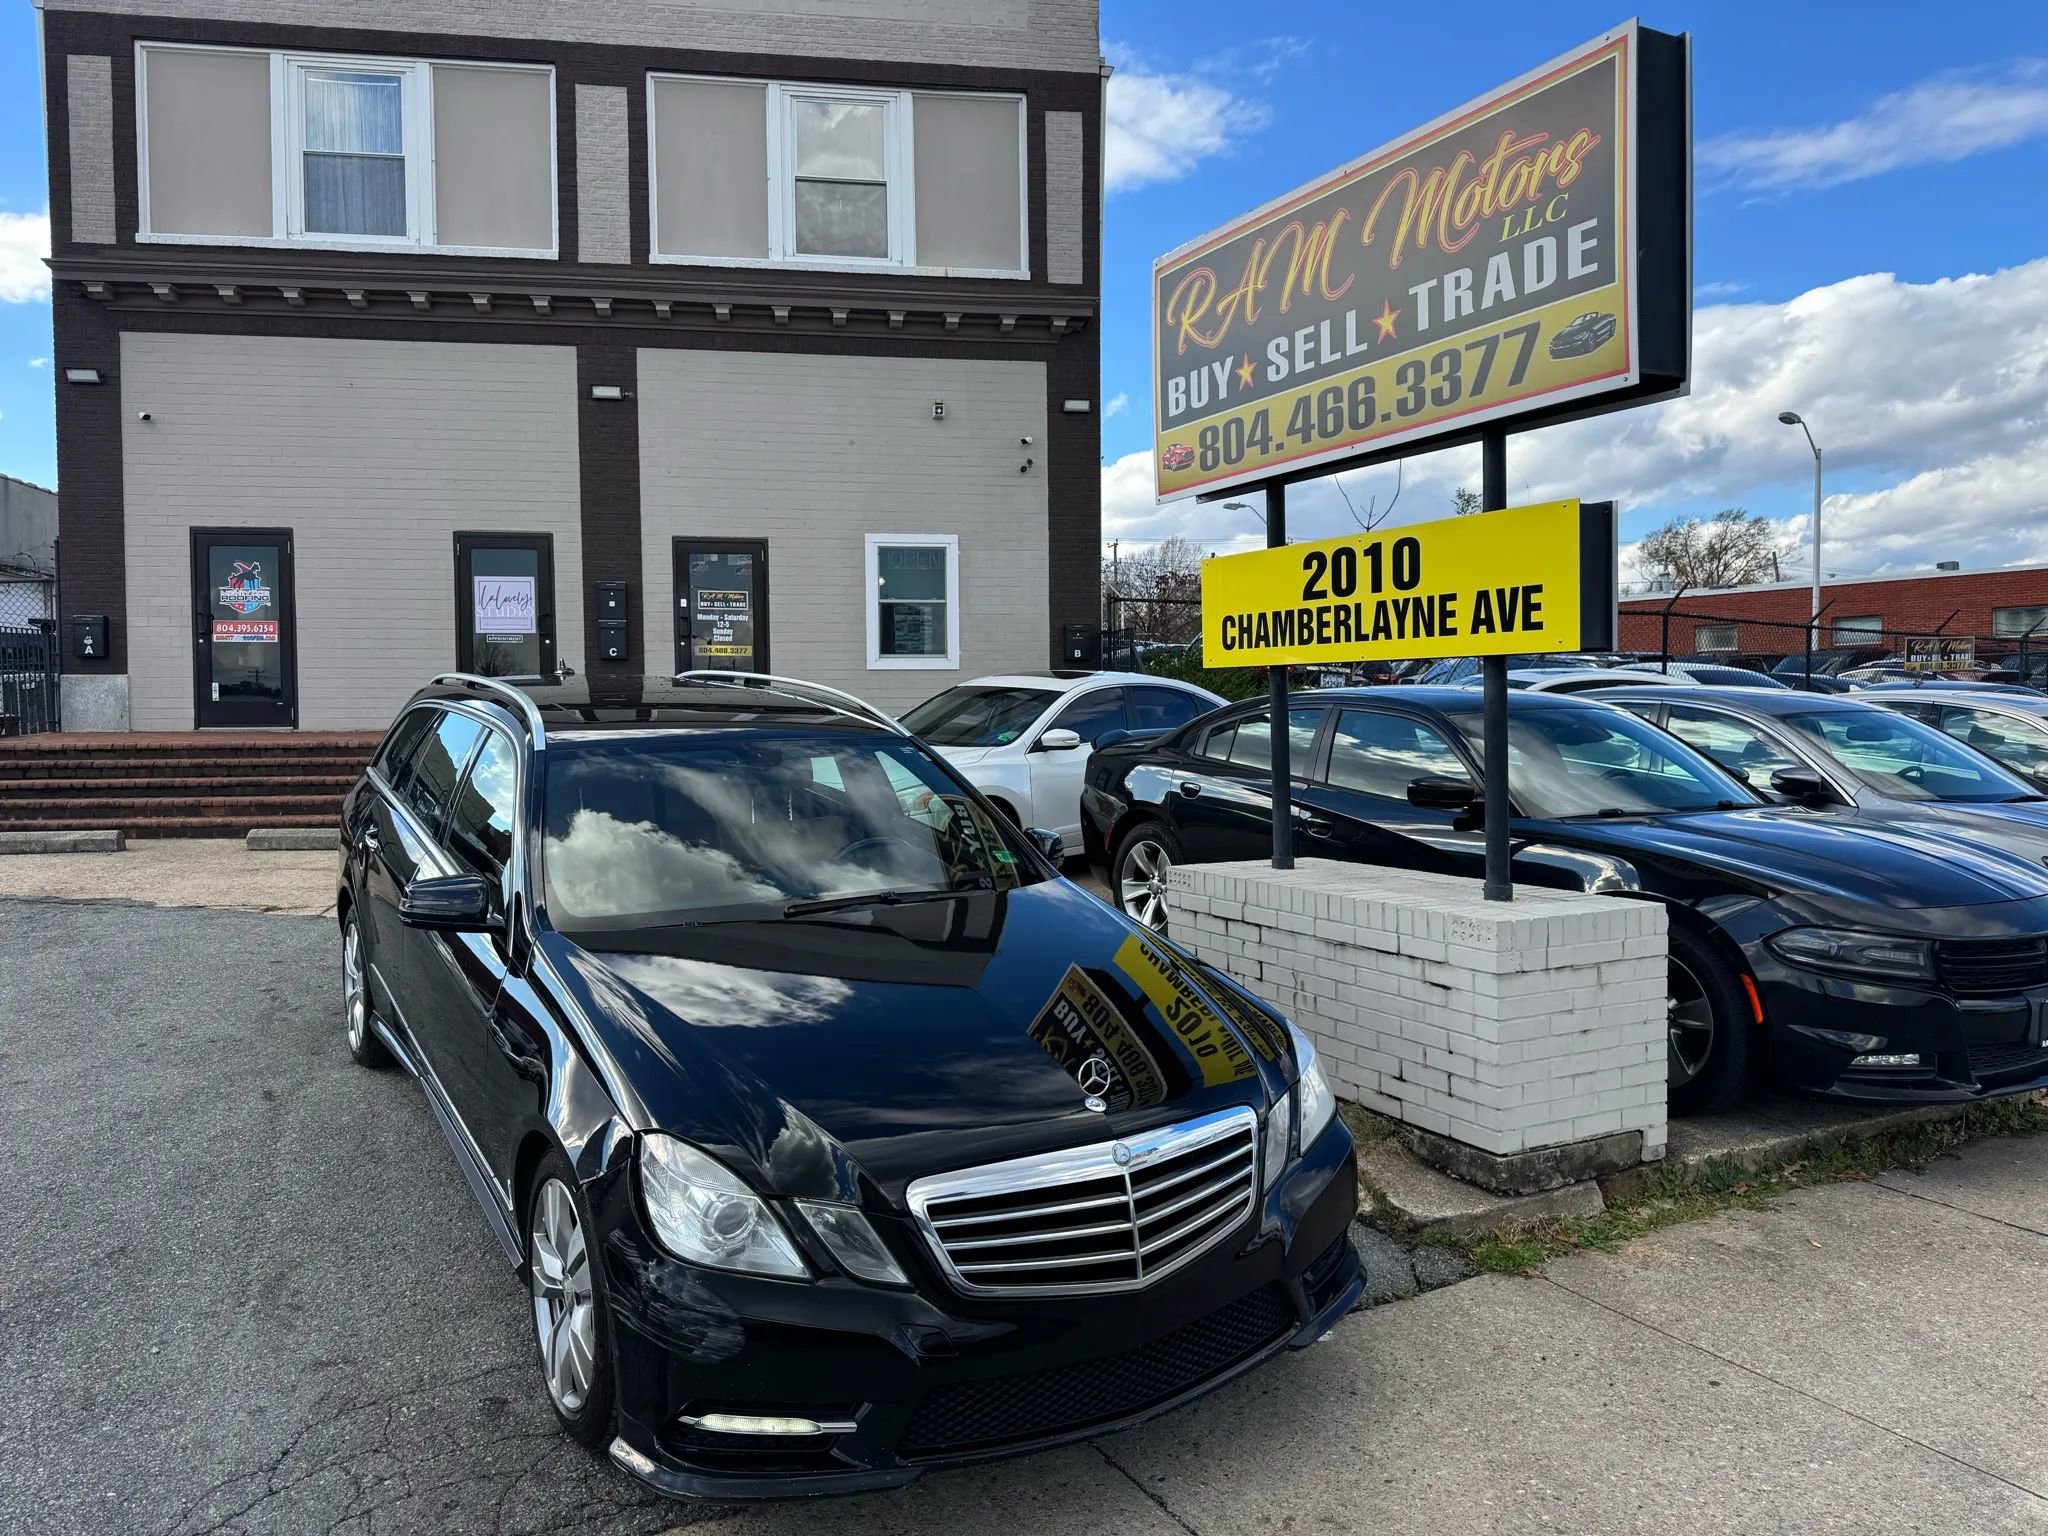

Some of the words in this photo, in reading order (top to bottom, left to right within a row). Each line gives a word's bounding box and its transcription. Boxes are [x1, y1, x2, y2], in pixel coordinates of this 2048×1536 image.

[1497, 191, 1570, 243] LLC
[1166, 207, 1356, 356] RAM
[1361, 127, 1602, 270] Motors
[1167, 355, 1235, 418] BUY
[1266, 308, 1368, 382] SELL
[1408, 217, 1598, 332] TRADE
[1198, 320, 1541, 472] 804.466.3377
[1302, 535, 1421, 602] 2010
[476, 606, 535, 617] STUDIO
[697, 613, 719, 621] Monday
[724, 613, 749, 622] Saturday
[1221, 592, 1458, 652] CHAMBERLAYNE
[1470, 583, 1544, 635] AVE
[712, 628, 734, 636] Sunday
[84, 645, 94, 655] A
[609, 647, 618, 656] C
[1074, 649, 1082, 658] B
[1910, 654, 1928, 662] BUY
